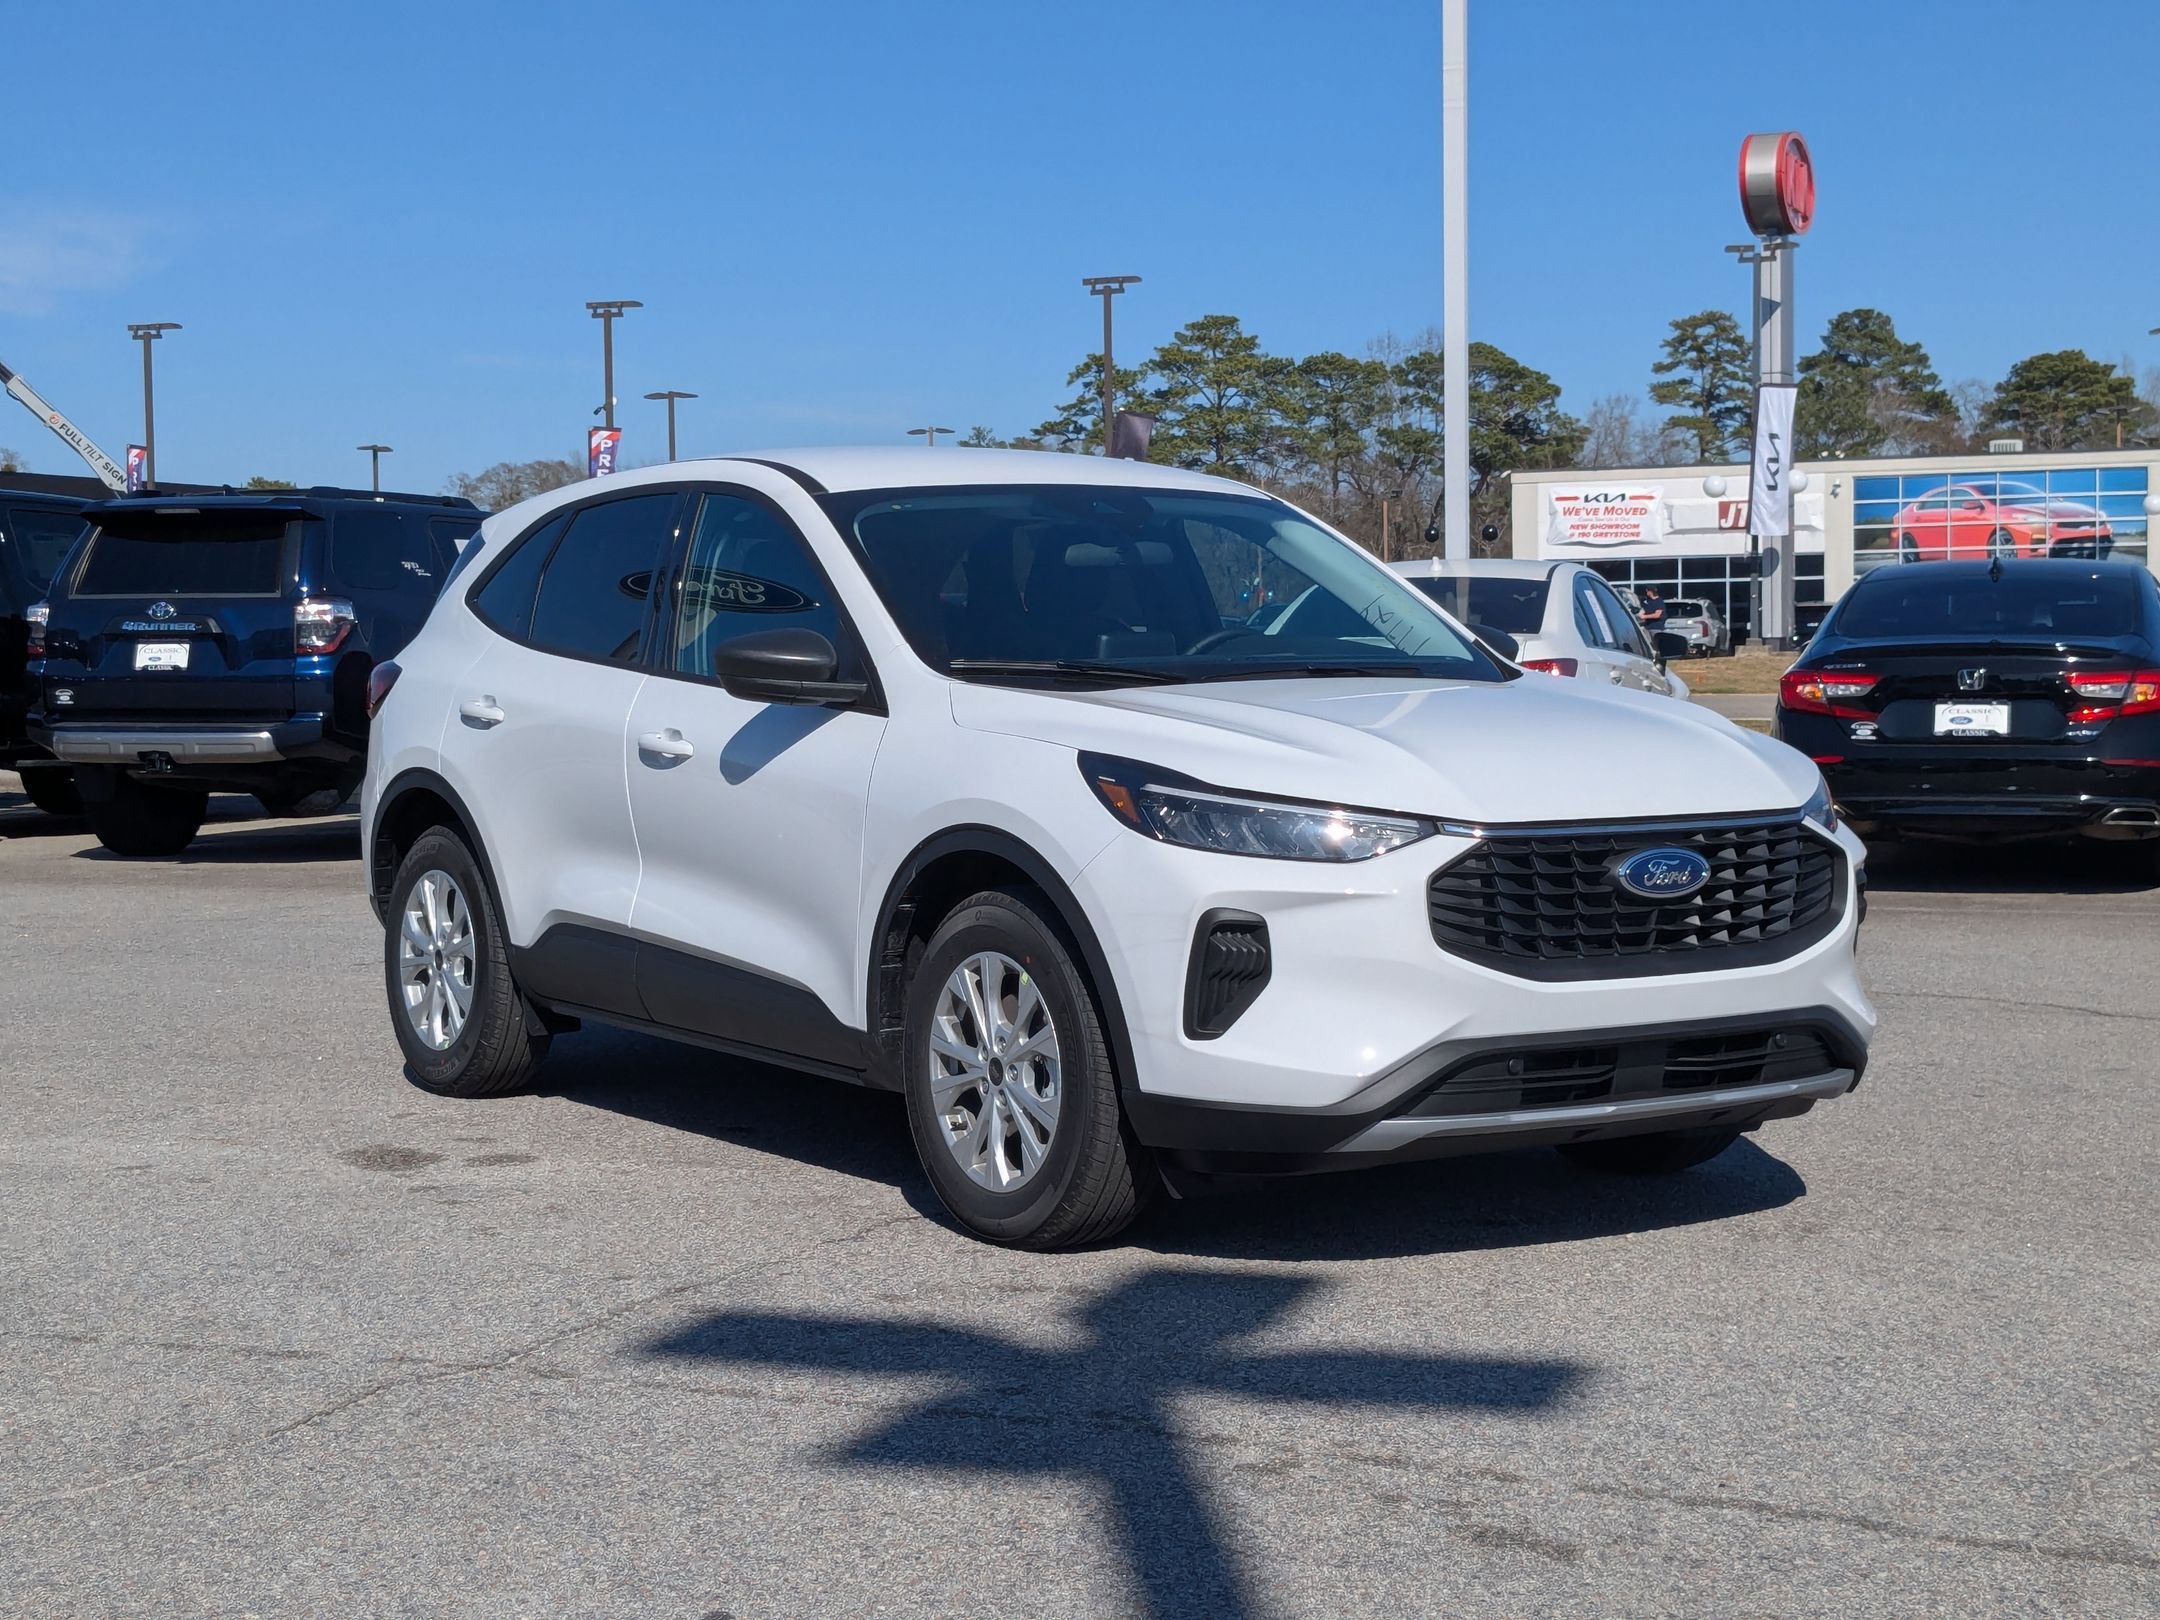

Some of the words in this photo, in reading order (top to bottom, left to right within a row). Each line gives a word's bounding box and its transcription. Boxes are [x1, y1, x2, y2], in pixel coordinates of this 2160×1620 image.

[59, 423, 82, 446] FULL
[83, 444, 104, 462] TILT
[1583, 493, 1626, 504] KIA
[1603, 506, 1648, 516] MOVED
[1643, 859, 1692, 887] Ford
